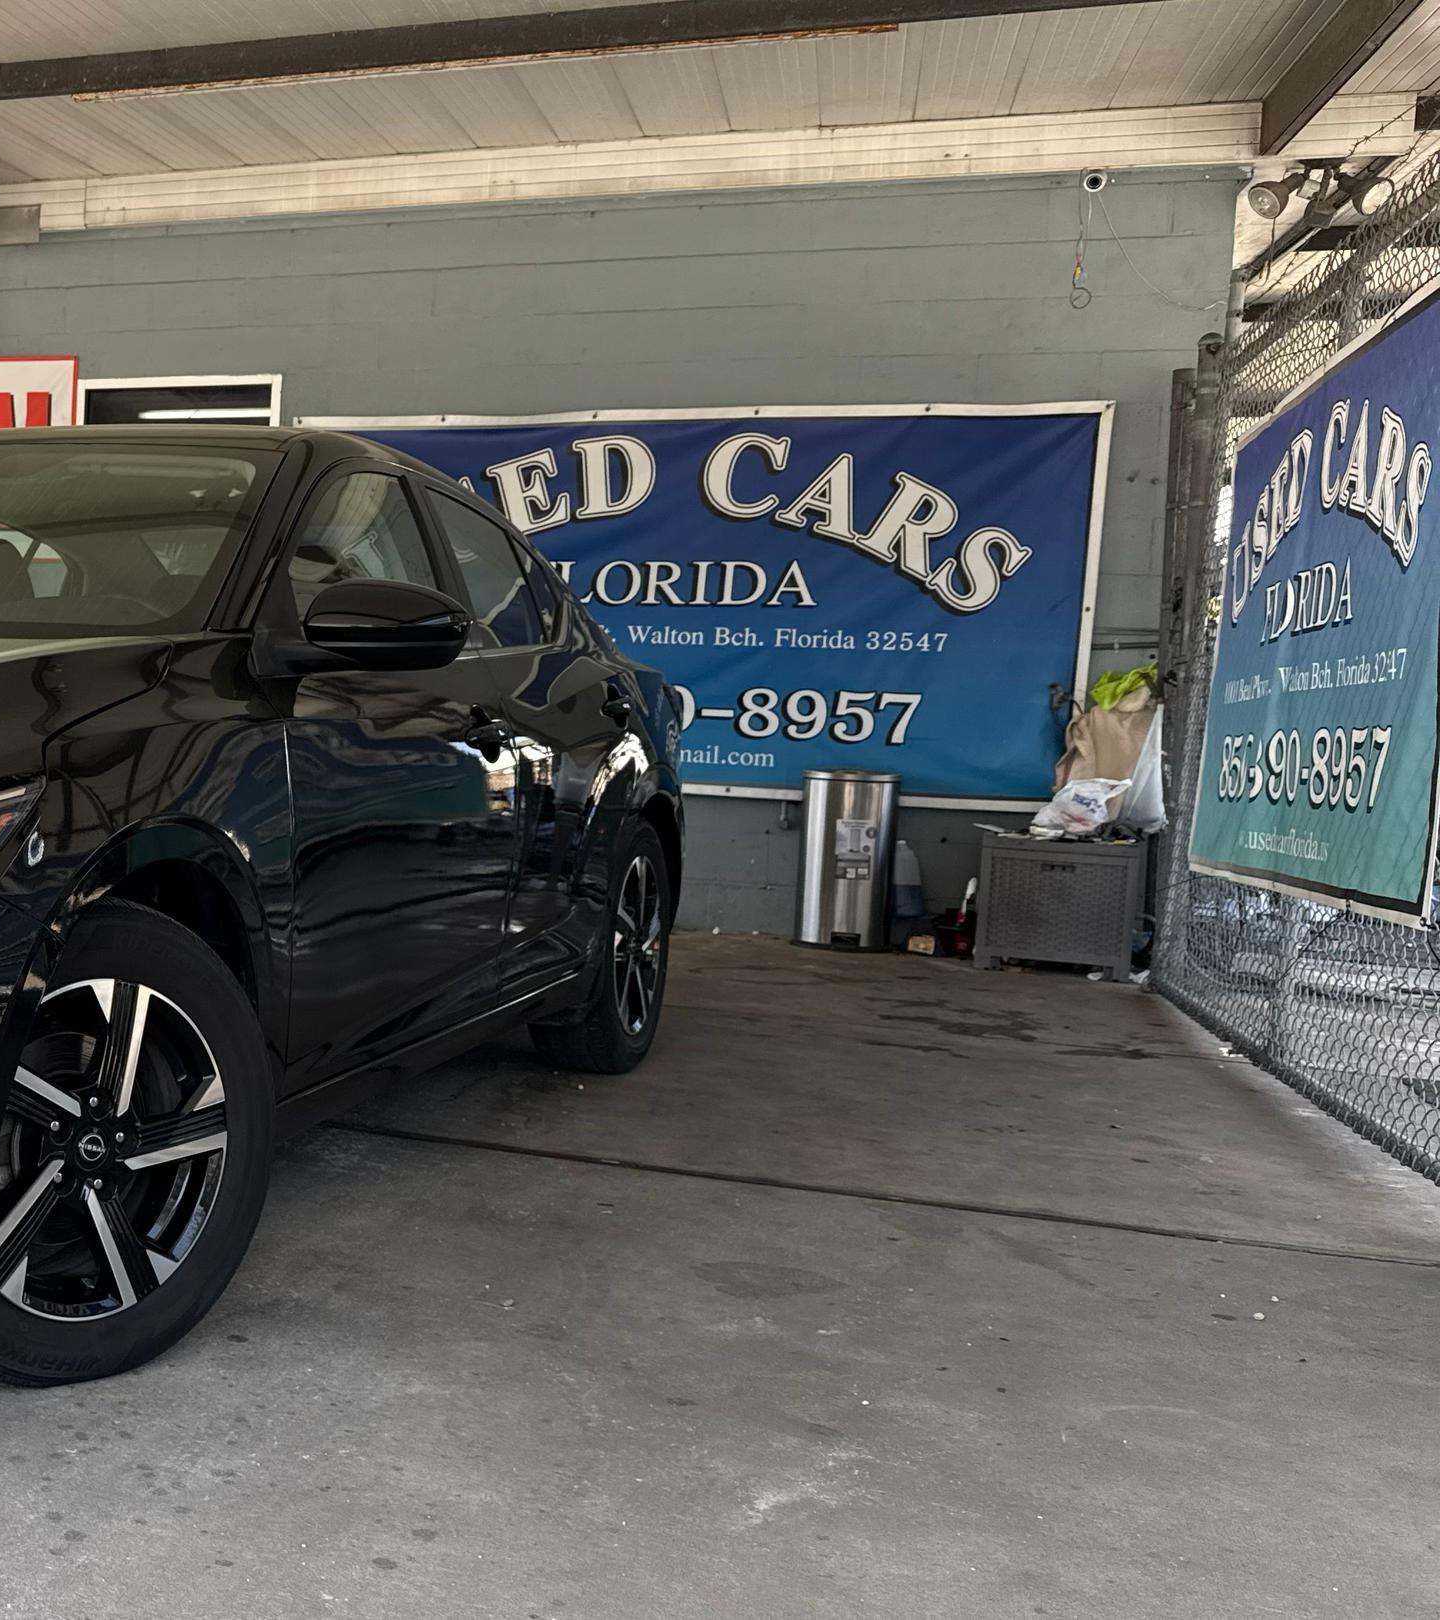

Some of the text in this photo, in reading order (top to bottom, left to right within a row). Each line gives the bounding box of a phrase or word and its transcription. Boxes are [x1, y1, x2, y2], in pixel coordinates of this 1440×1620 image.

[459, 432, 1034, 613] ED CARS
[1231, 399, 1433, 623] USED CARS
[556, 560, 818, 607] LORIDA
[627, 625, 705, 646] Walton
[713, 627, 765, 647] Bch.
[774, 628, 856, 650] Florida
[865, 631, 949, 652] 32547
[1310, 660, 1333, 690] Bch.
[1371, 648, 1407, 684] 3247
